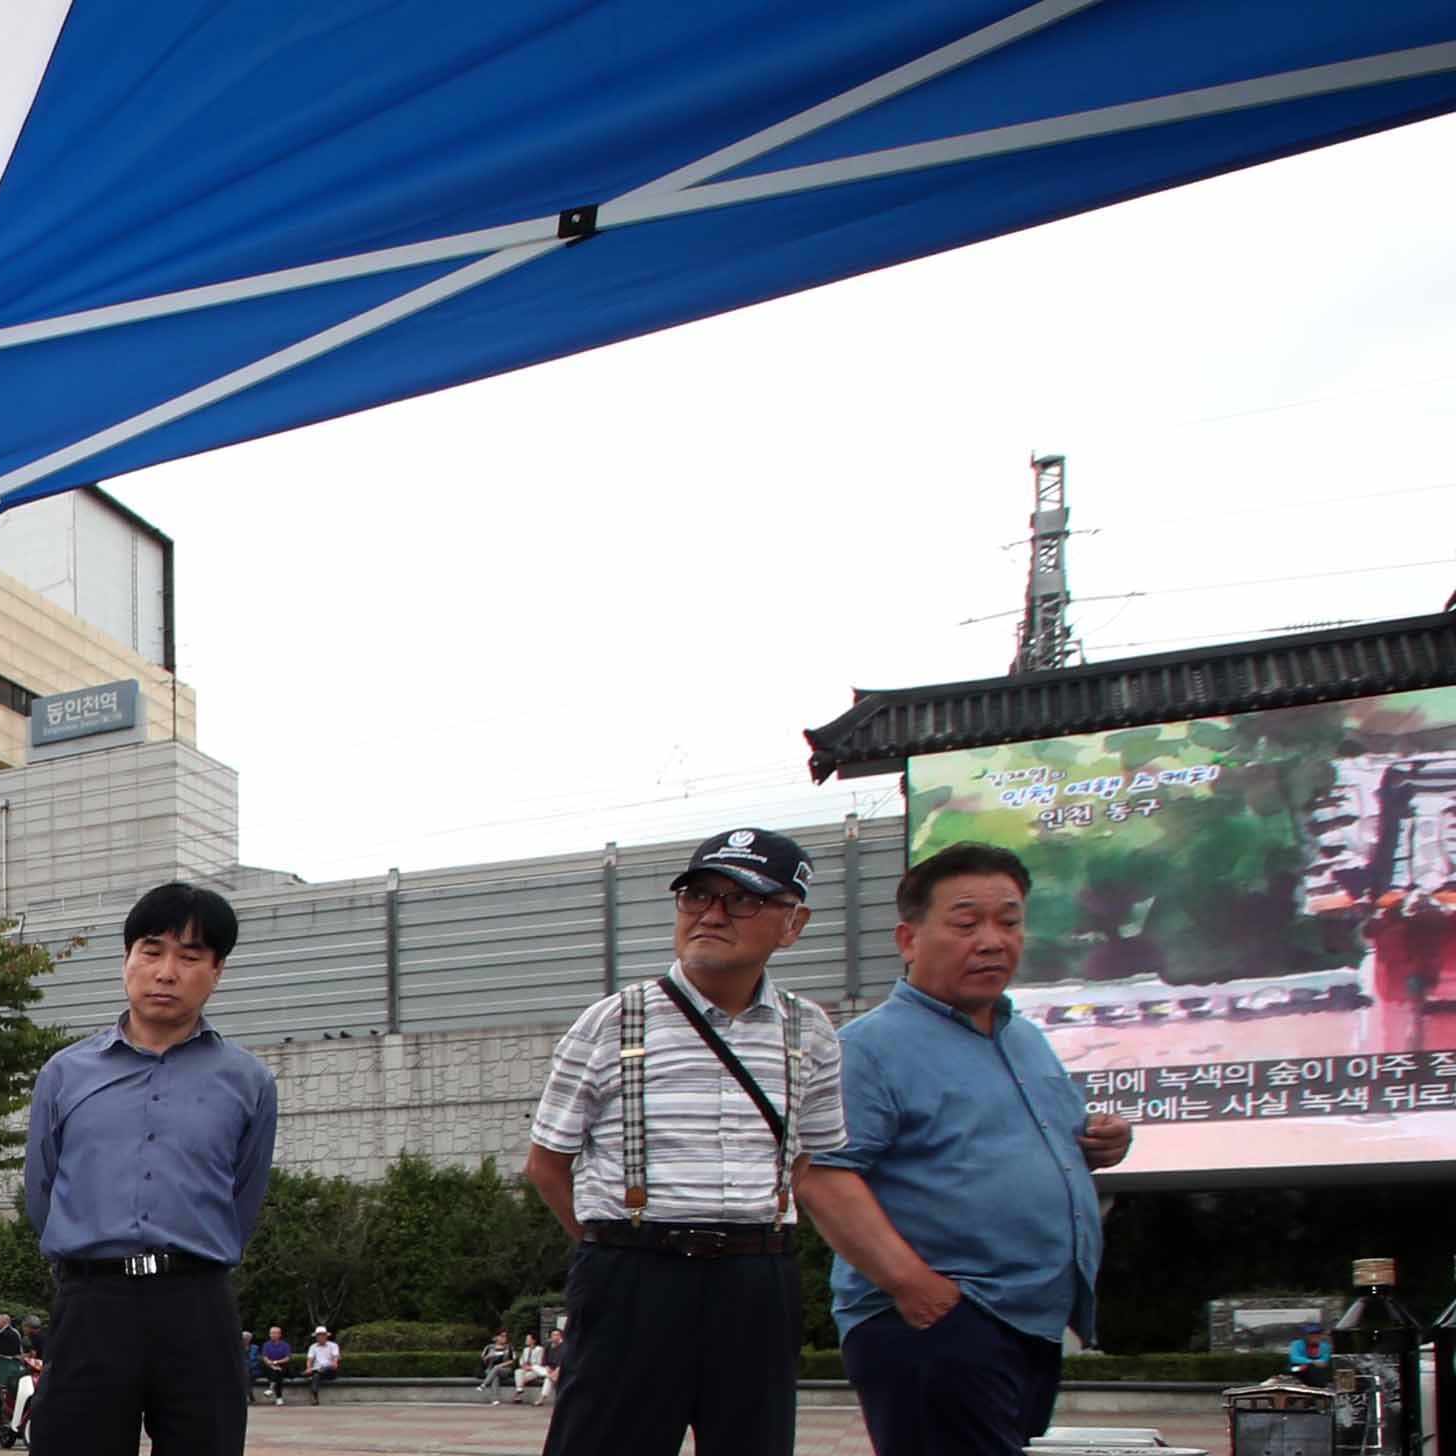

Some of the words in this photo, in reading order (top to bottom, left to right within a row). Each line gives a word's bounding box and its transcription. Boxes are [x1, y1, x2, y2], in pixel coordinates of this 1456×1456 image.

[47, 690, 118, 725] 동인천역
[1001, 784, 1056, 808] 인천
[1064, 776, 1122, 799] 여행
[1128, 765, 1220, 792] 스케치
[1039, 804, 1093, 829] 인천
[1105, 798, 1161, 823] 동구
[1085, 1069, 1147, 1095] 뒤에
[1157, 1063, 1255, 1091] 녹색의
[1266, 1058, 1334, 1085] 숲이
[1346, 1054, 1418, 1080] 아주
[1221, 1089, 1289, 1117] 사실
[1299, 1084, 1370, 1112] 녹색
[1380, 1080, 1456, 1109] 뒤로
